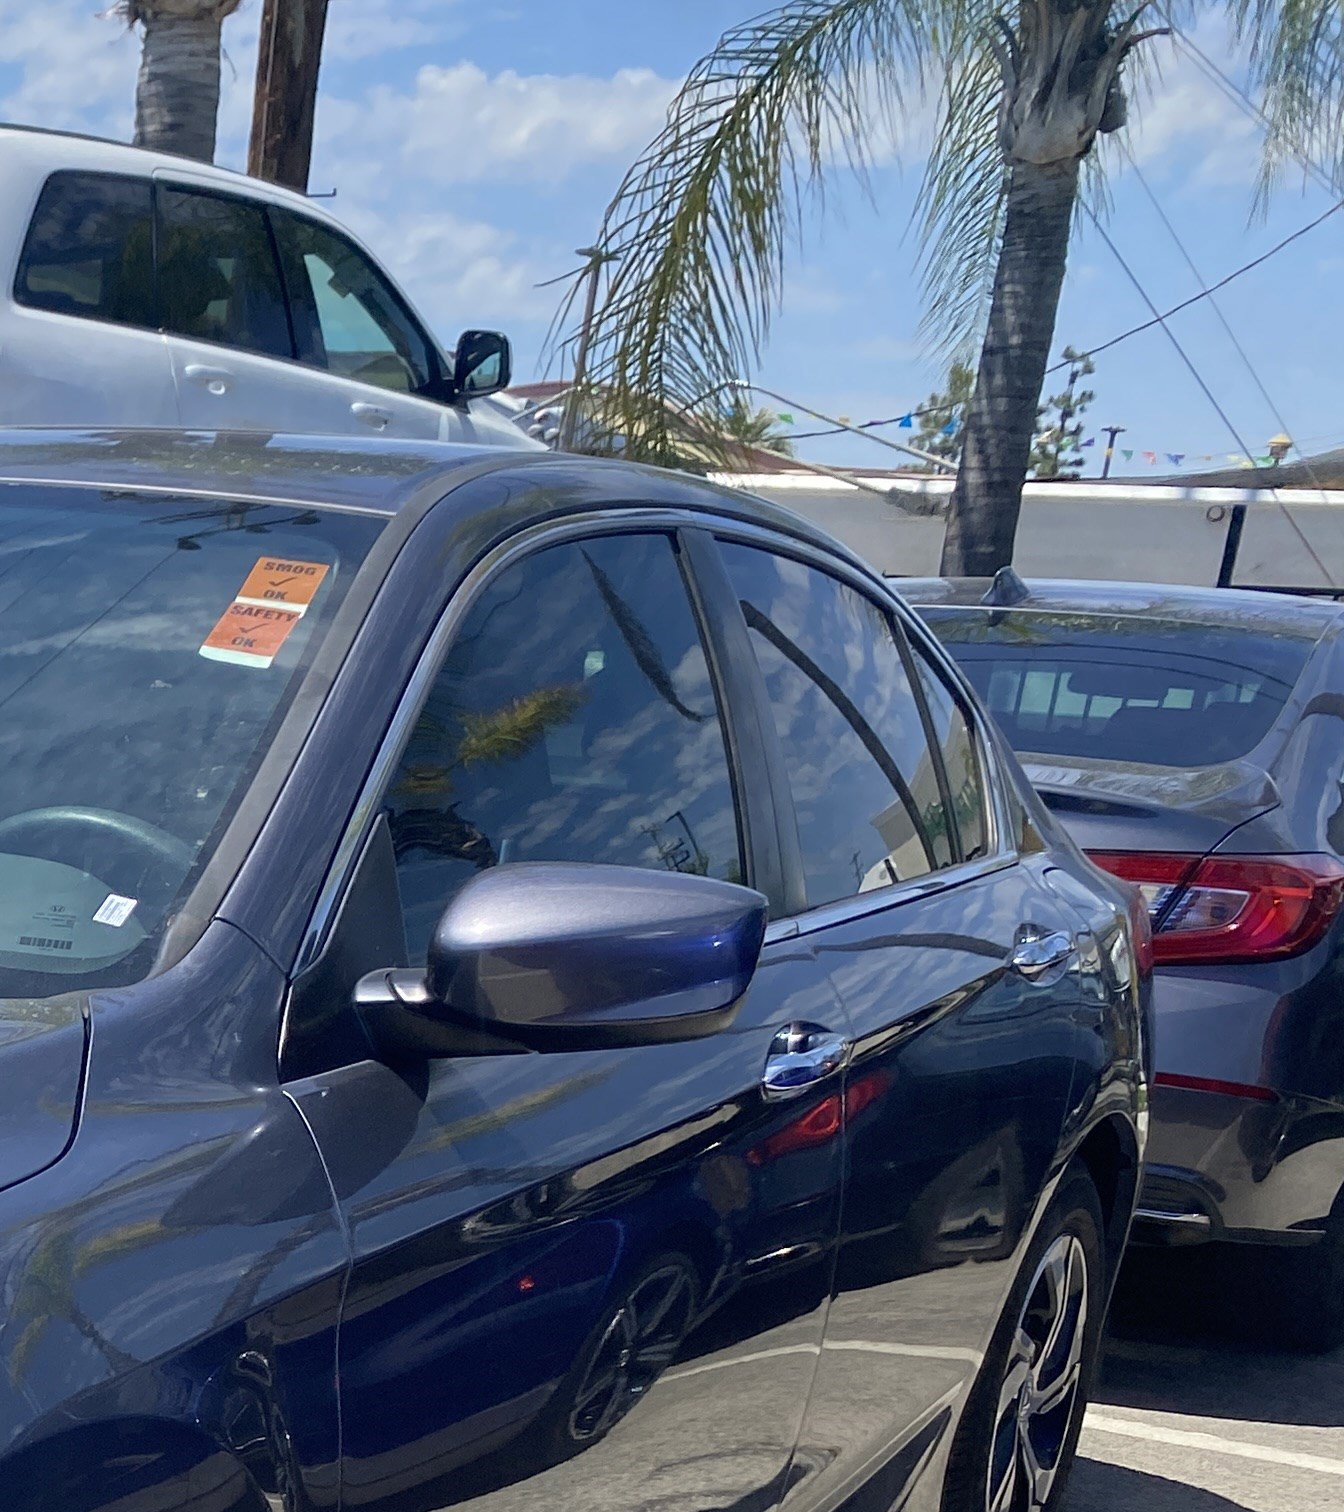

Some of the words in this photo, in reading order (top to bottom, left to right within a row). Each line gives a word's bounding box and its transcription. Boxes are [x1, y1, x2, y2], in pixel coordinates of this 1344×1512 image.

[264, 562, 318, 576] SMOG
[263, 589, 288, 600] OK
[230, 605, 300, 622] SAFETY
[231, 636, 257, 648] OK
